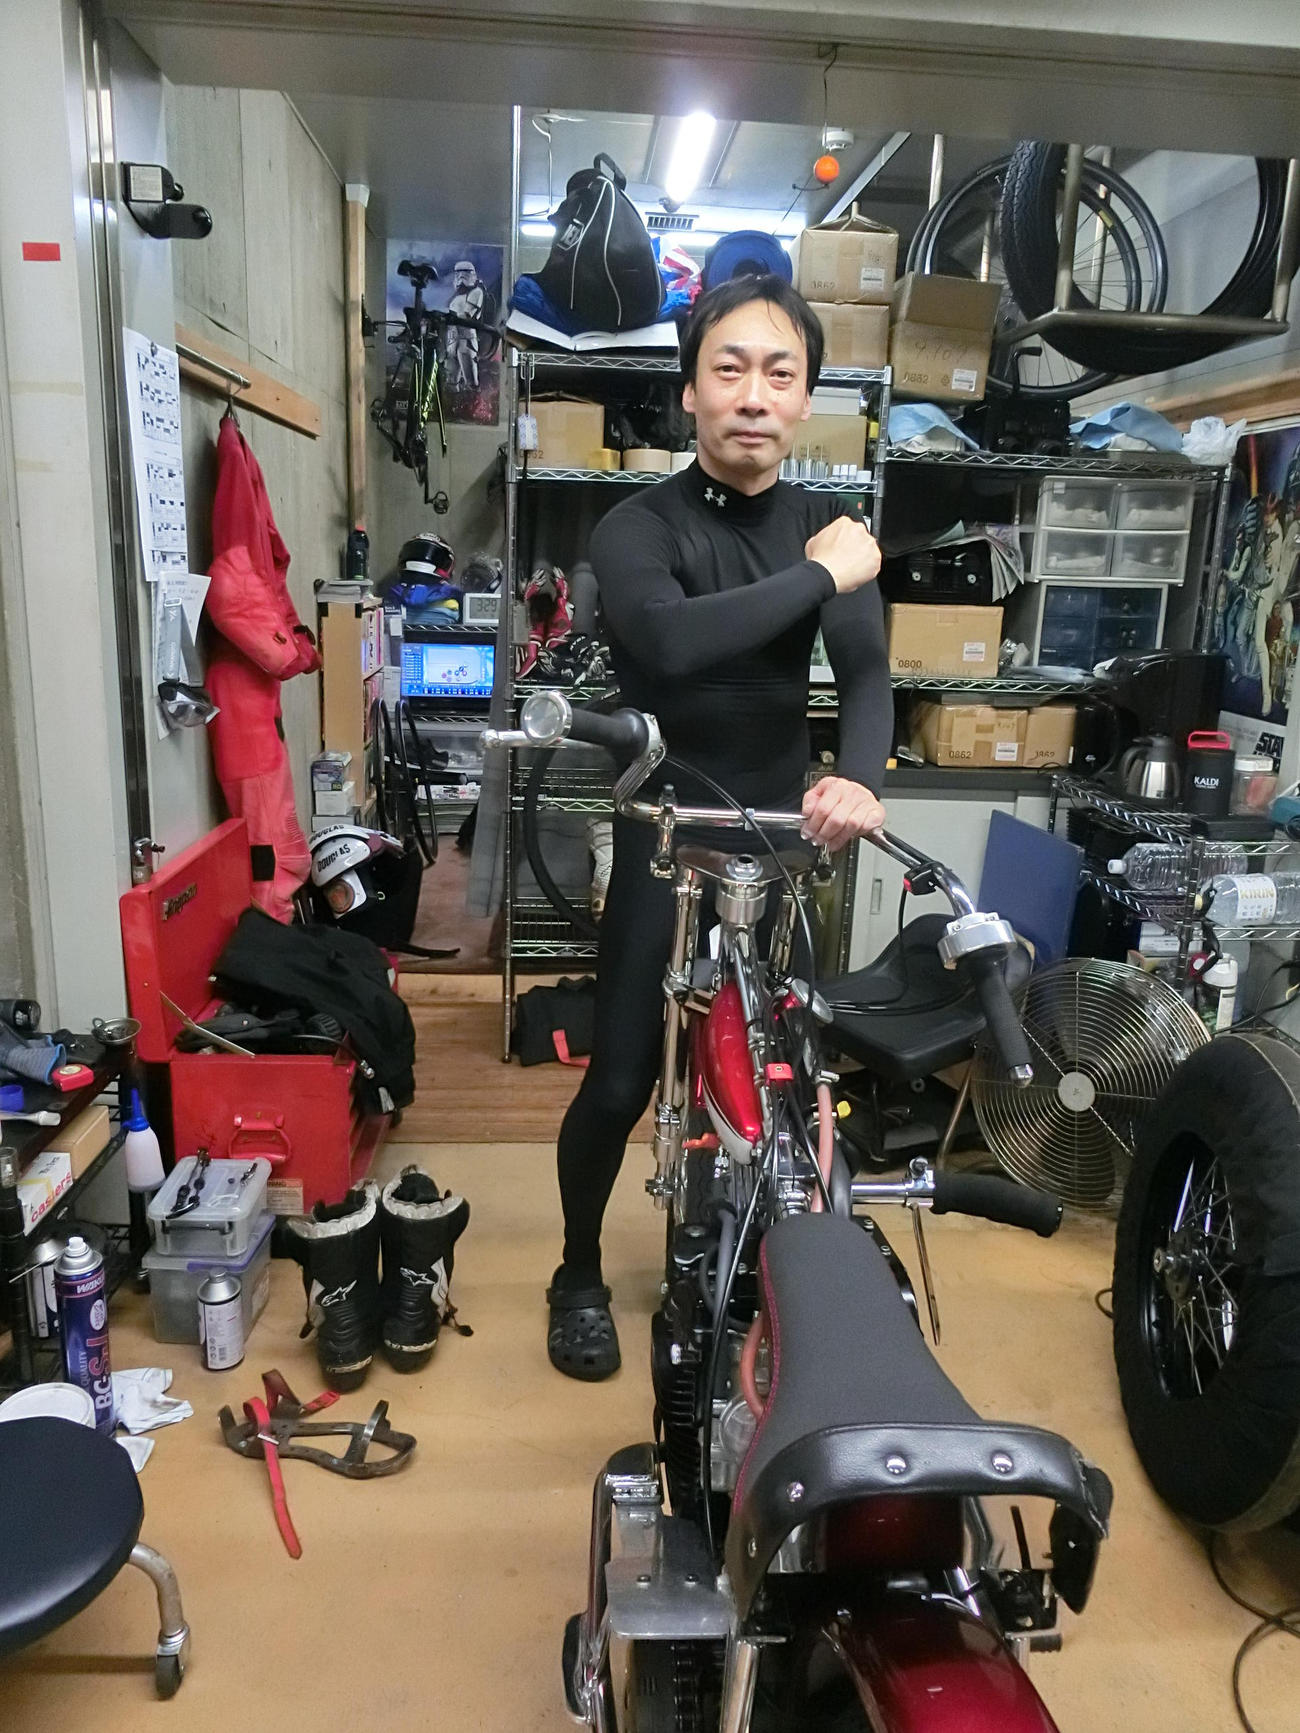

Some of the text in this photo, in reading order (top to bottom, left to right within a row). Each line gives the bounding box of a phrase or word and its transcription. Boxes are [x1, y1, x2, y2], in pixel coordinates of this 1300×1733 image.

[898, 659, 922, 669] 0800
[949, 750, 971, 760] 0862
[1194, 776, 1219, 786] KALDI
[1240, 887, 1274, 899] KIRIN
